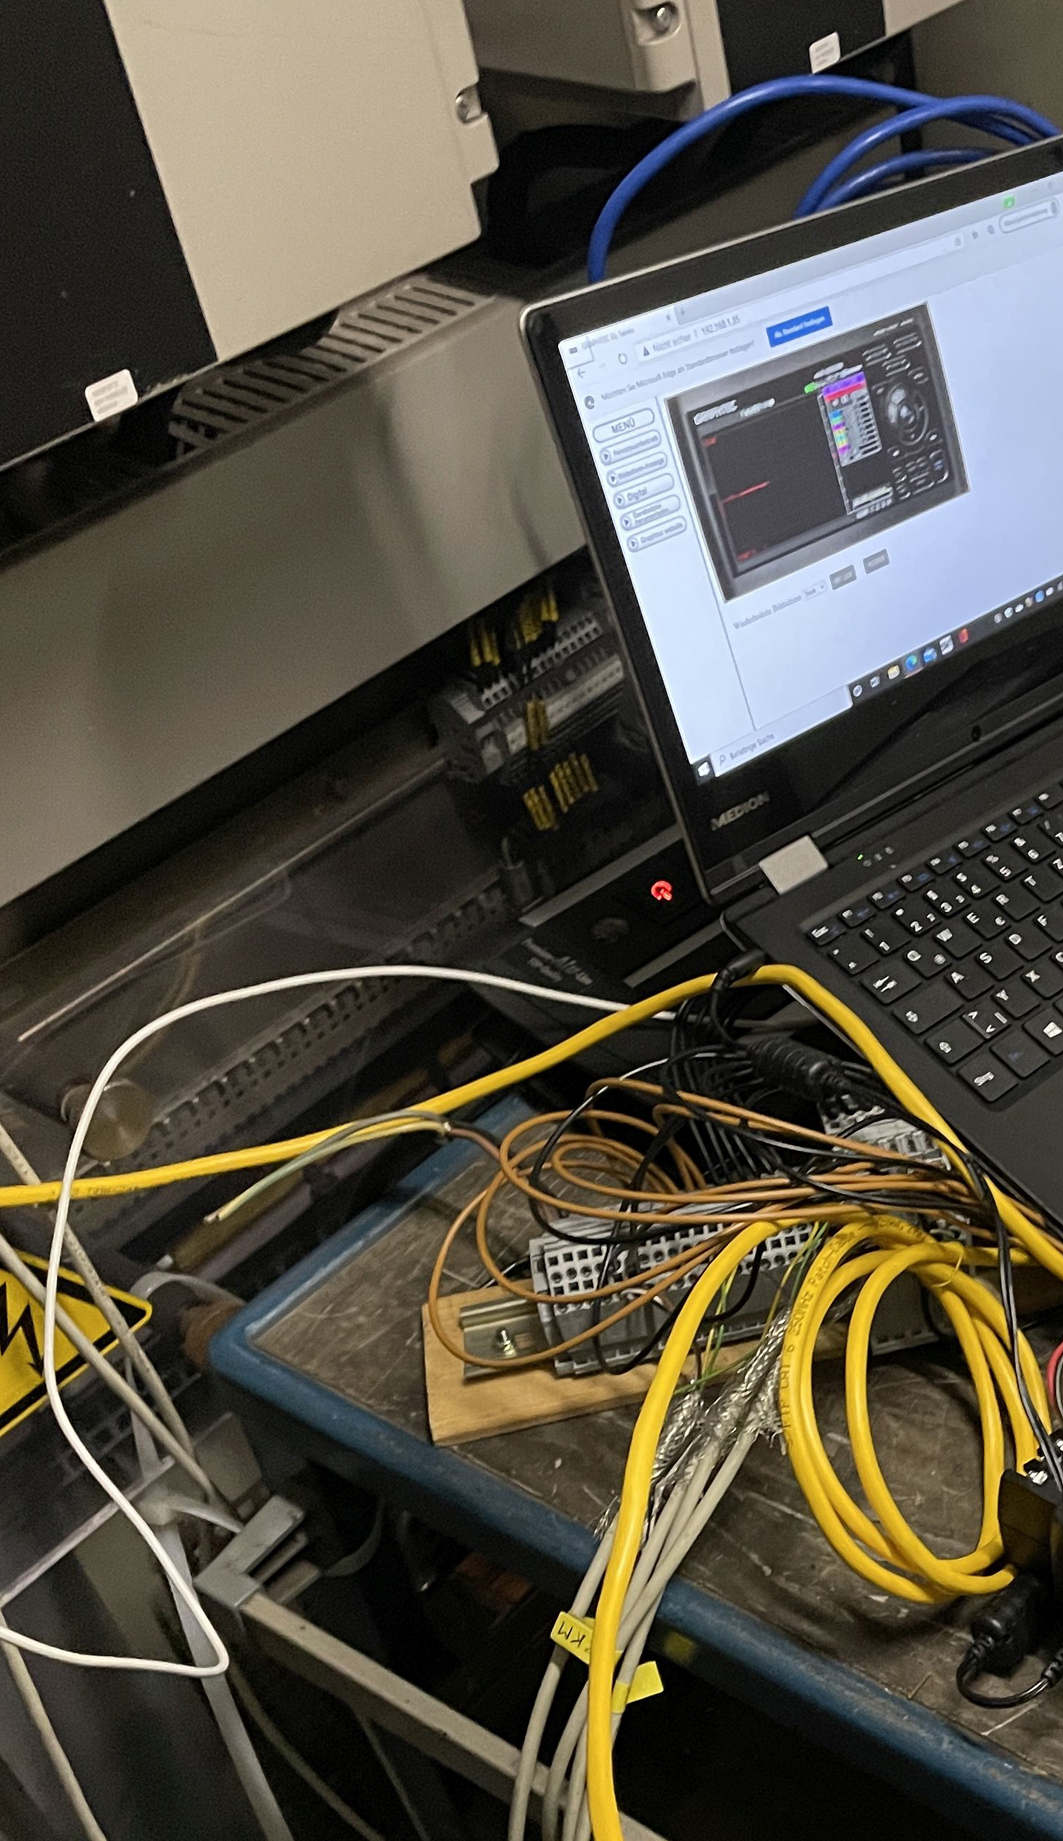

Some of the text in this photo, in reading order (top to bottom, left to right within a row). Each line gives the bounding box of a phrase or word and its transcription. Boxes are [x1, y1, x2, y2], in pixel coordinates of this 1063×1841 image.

[611, 417, 635, 433] MENÜ
[710, 791, 770, 831] MEDION
[1024, 875, 1037, 886] T
[995, 894, 1009, 906] R
[966, 912, 980, 924] E
[1037, 915, 1047, 926] F
[1008, 934, 1022, 945] D
[979, 952, 993, 964] S
[950, 971, 965, 983] A
[1025, 970, 1041, 982] X
[783, 1343, 795, 1353] 6
